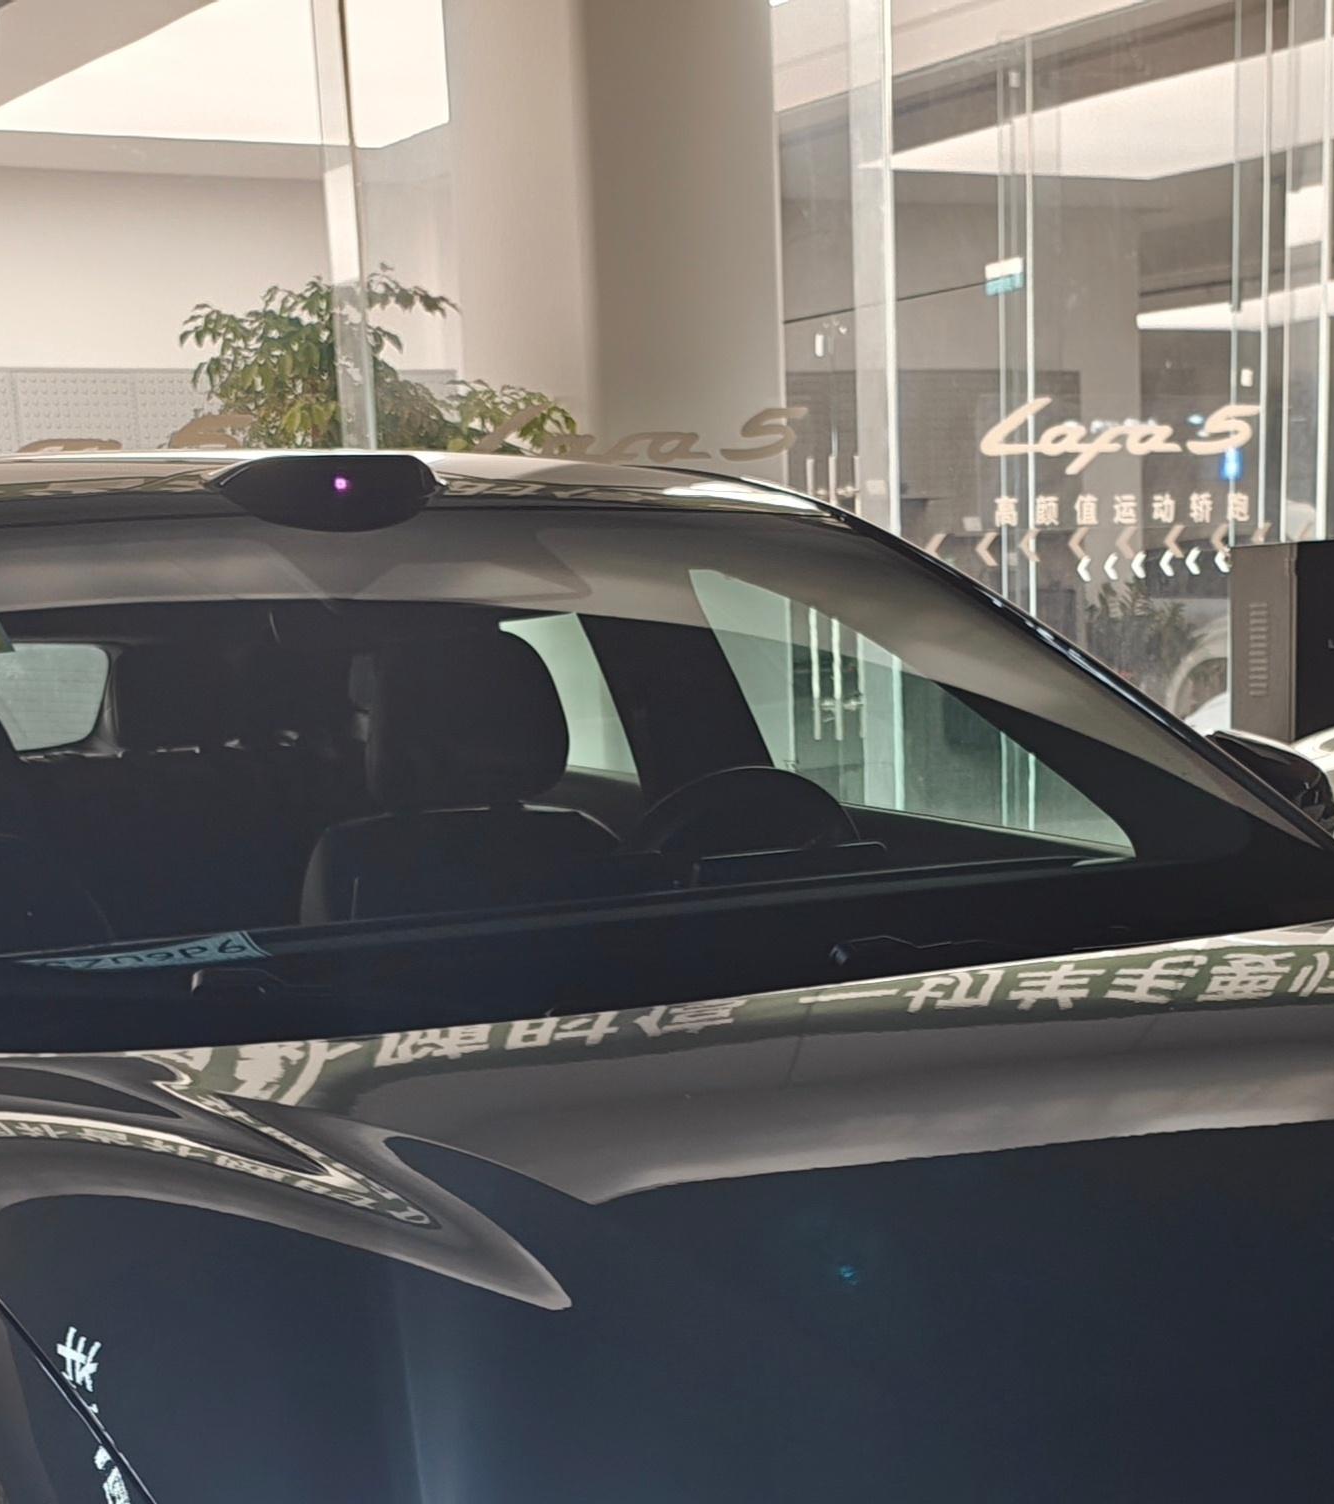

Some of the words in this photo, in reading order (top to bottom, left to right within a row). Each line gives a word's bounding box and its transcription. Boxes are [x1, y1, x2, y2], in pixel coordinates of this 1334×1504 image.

[993, 492, 1251, 527] 高颜值运动轿跑
